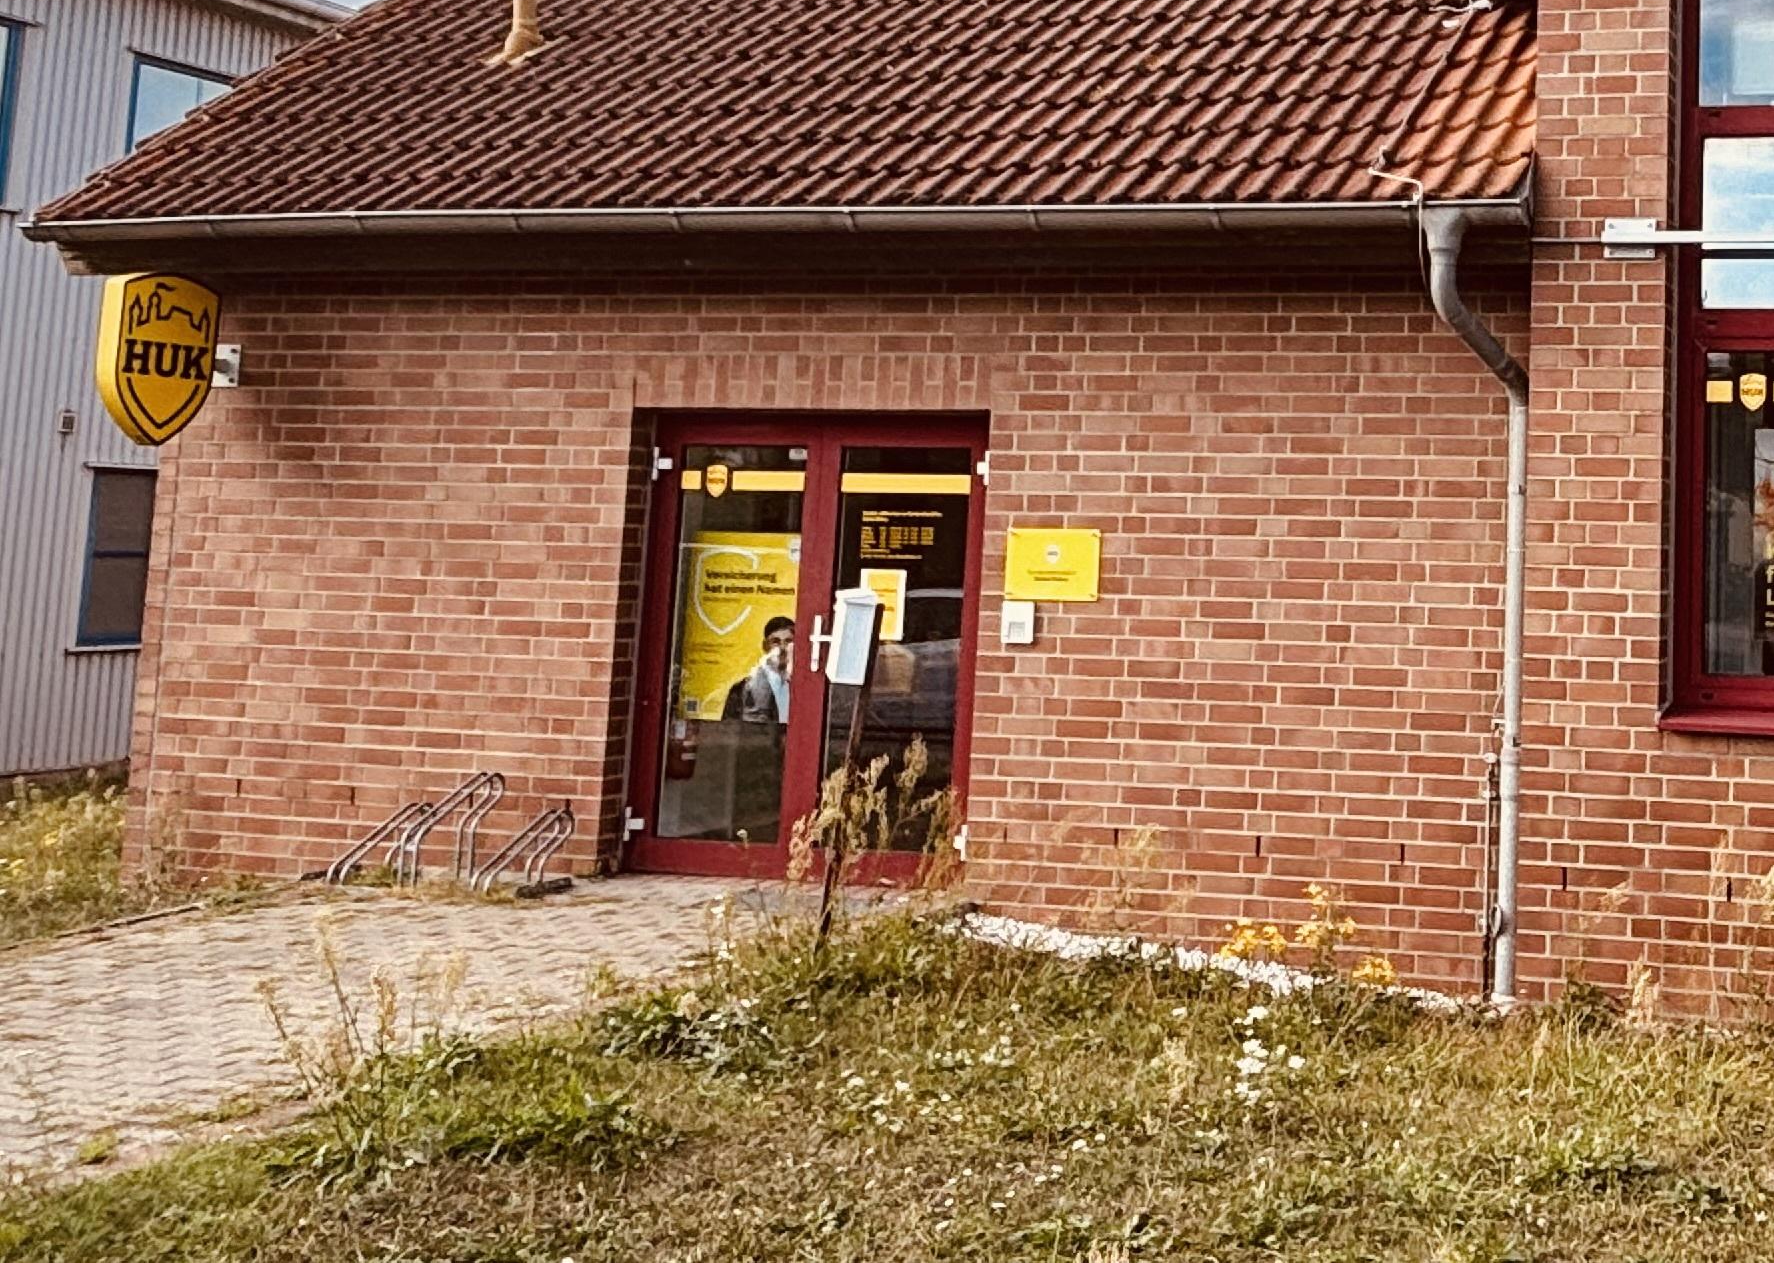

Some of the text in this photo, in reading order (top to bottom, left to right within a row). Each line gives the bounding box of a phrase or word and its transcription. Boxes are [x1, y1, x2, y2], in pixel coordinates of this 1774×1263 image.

[121, 338, 209, 381] HUK
[705, 569, 777, 583] Versicherung
[704, 583, 795, 596] hat einen Namen
